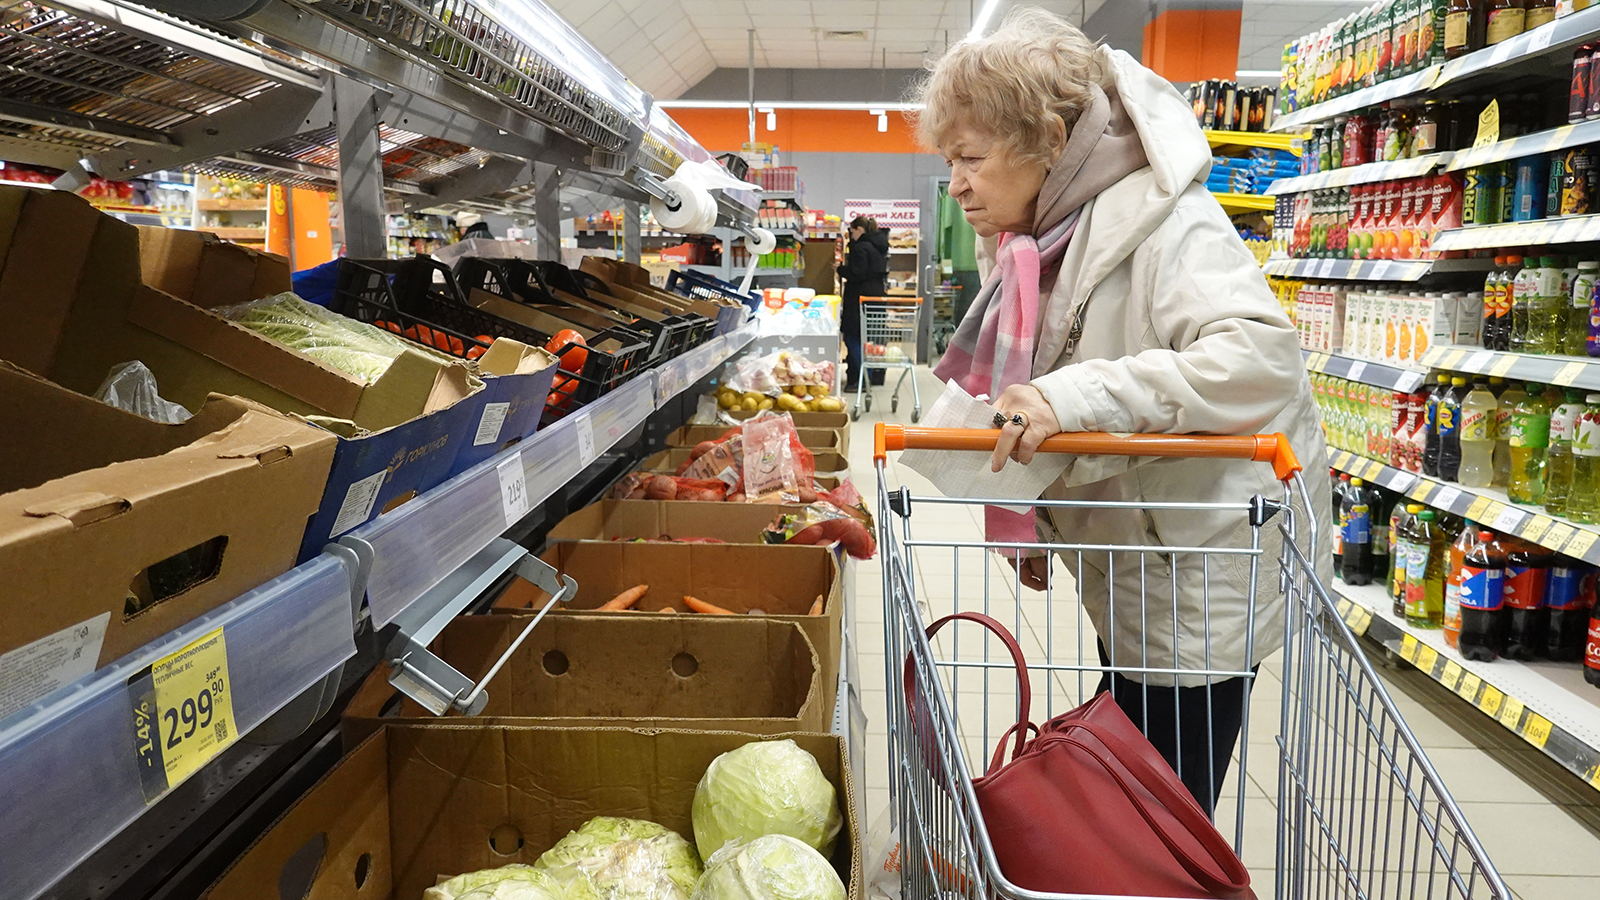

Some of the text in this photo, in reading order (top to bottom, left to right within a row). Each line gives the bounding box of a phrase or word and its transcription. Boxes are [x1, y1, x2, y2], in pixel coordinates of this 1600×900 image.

[890, 211, 915, 219] ХЛЕБ
[155, 661, 194, 685] ТЕПЛИЧНЫЕ ВЕС
[164, 689, 213, 750] 299
[212, 678, 224, 696] 90
[135, 702, 153, 766] -14%
[1530, 725, 1543, 739] 104
